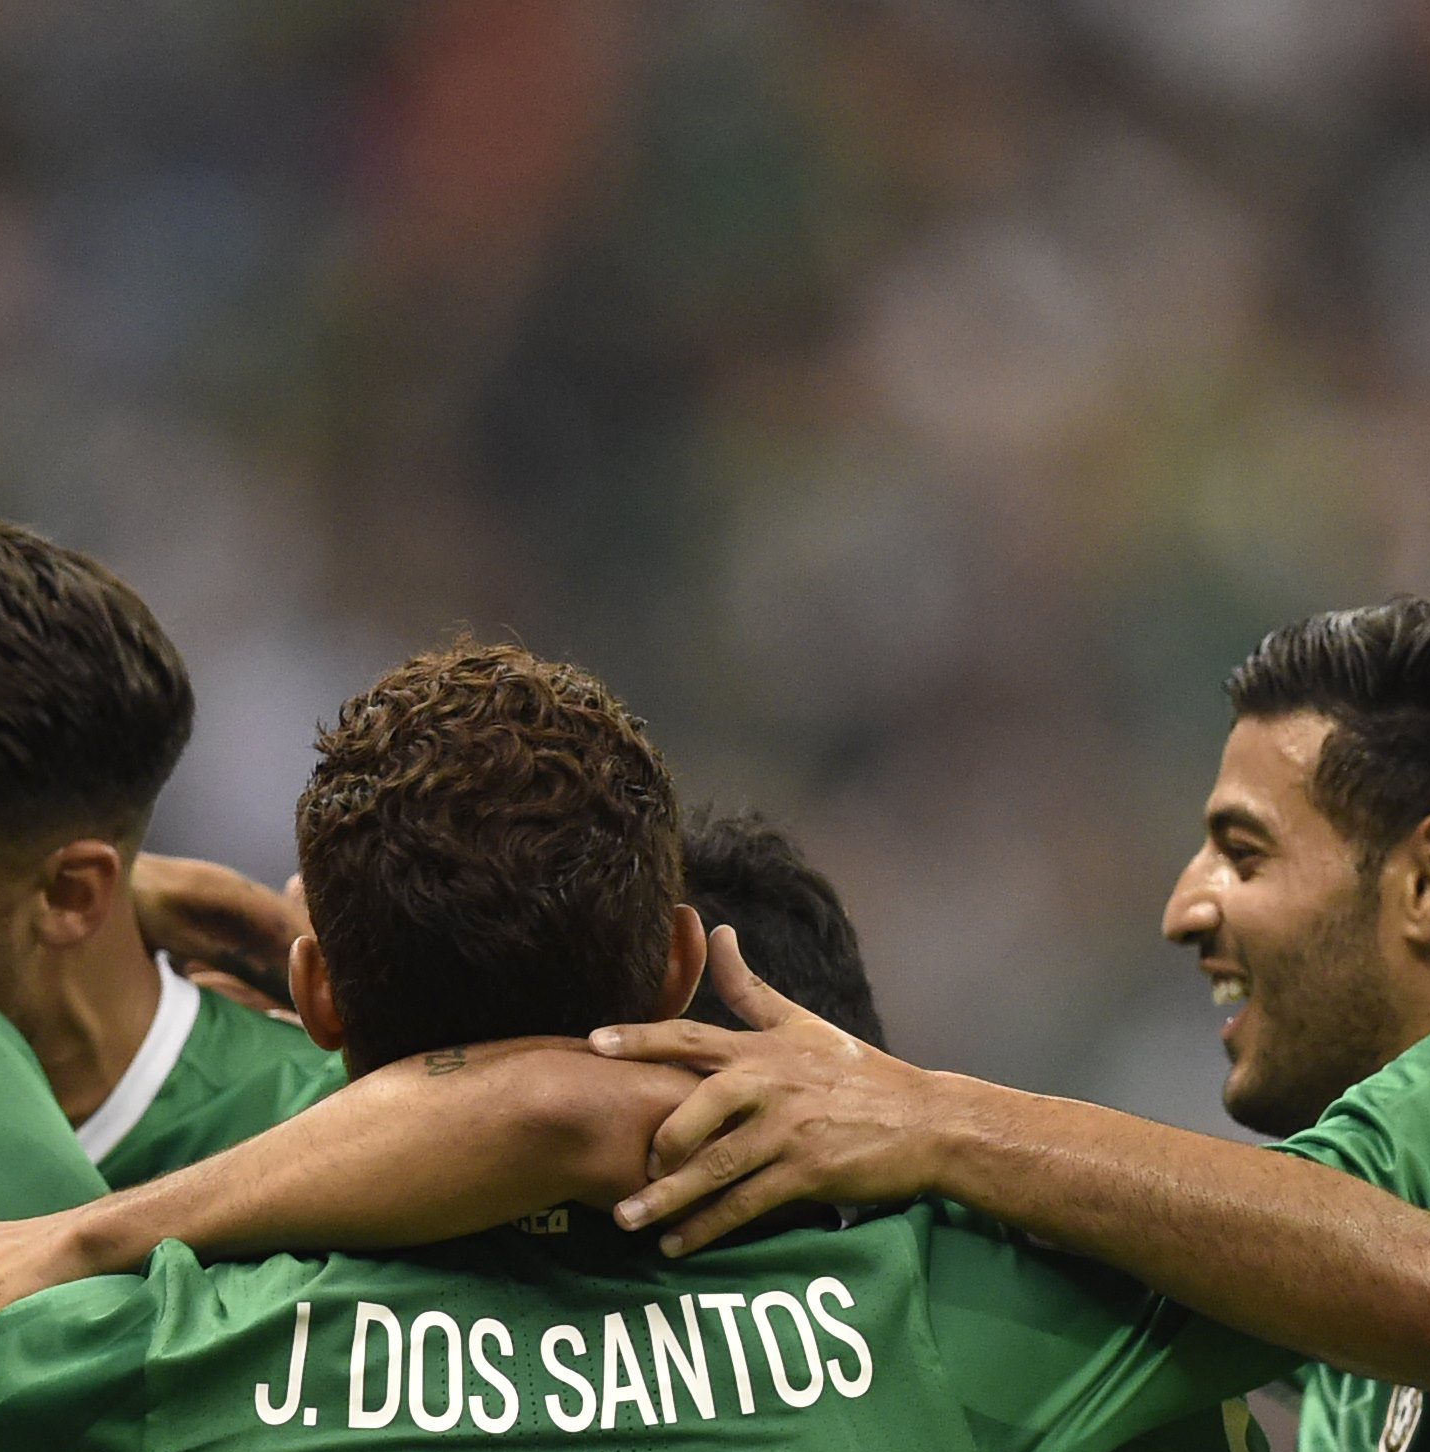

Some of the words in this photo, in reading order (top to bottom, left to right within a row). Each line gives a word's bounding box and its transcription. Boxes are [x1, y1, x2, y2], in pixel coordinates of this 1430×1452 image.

[251, 1302, 317, 1425] J.
[349, 1302, 519, 1433] DOS
[541, 1277, 872, 1432] SANTOS
